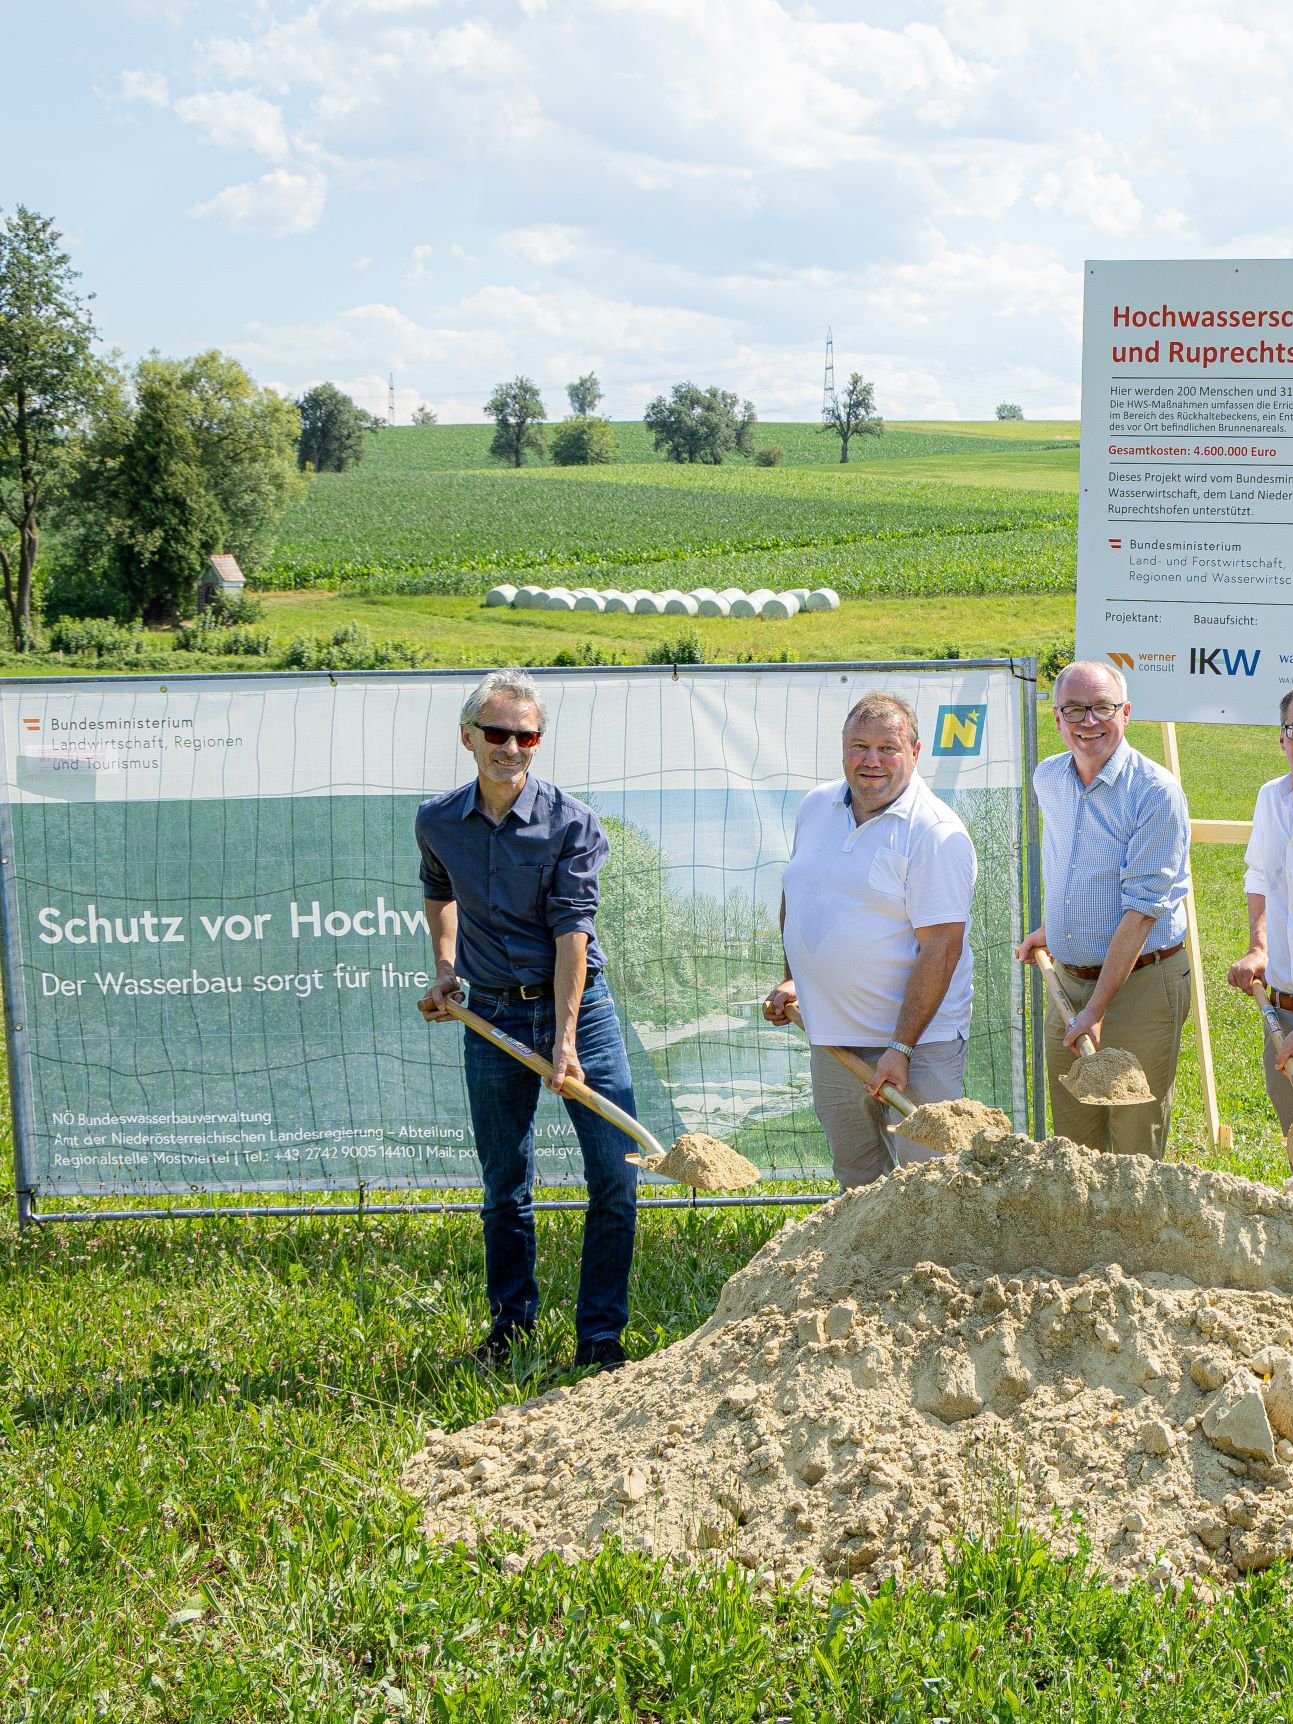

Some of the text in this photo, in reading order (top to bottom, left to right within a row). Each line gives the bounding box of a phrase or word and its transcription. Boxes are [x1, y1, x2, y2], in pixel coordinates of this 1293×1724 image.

[1112, 340, 1159, 363] und
[1110, 386, 1131, 396] Hier
[1135, 386, 1174, 397] werden
[1177, 387, 1196, 397] 200
[1200, 387, 1253, 397] Menschen
[1256, 387, 1276, 397] und
[1280, 388, 1292, 397] 31
[1110, 400, 1124, 409] Die
[1127, 400, 1209, 410] HWS-Maßnahmen
[1211, 401, 1254, 410] umfassen
[1256, 401, 1270, 410] die
[1110, 411, 1121, 420] im
[1123, 411, 1156, 420] Bereich
[1159, 411, 1174, 420] des
[1177, 411, 1260, 422] Rückhaltebeckens,
[1262, 412, 1276, 421] ein
[1109, 422, 1125, 431] des
[1144, 423, 1158, 431] Ort
[1161, 423, 1215, 432] befindlichen
[1219, 424, 1287, 433] Brunnenareals.
[1108, 445, 1276, 457] Gesamtkosten: 4.600.000 Euro
[1109, 472, 1141, 483] Dieses
[1145, 472, 1181, 485] Projekt
[1184, 473, 1207, 483] wird
[1210, 476, 1233, 484] vom
[1108, 488, 1200, 501] Wasserwirtschaft,
[1203, 489, 1226, 499] dem
[1230, 489, 1254, 500] Land
[1108, 504, 1254, 517] Ruprechtshofen unterstützt.
[1130, 540, 1242, 552] Bundesministerium
[1129, 555, 1286, 570] Land- und Forstwirtschaft,
[1129, 570, 1182, 584] Regionen
[1186, 572, 1207, 582] und
[1105, 612, 1162, 624] Projektant:
[1194, 614, 1258, 626] Bauaufsicht:
[1138, 652, 1176, 662] werner
[1190, 648, 1261, 676] IKW
[1138, 663, 1175, 673] consult
[51, 718, 193, 731] Bundesministerium
[52, 735, 243, 751] Landwirtschaft, Regionen
[53, 758, 159, 771] und Tourismus
[38, 904, 184, 945] Schutz
[200, 911, 272, 942] vor
[42, 972, 86, 996] Der
[94, 969, 242, 996] Wasserbau
[254, 969, 323, 998] sorgt
[333, 963, 370, 989] für
[382, 962, 429, 988] Ihre
[53, 1110, 272, 1126] NÖ Bundeswasserbauverwaltung
[54, 1133, 79, 1146] Amt
[84, 1133, 105, 1146] der
[112, 1131, 265, 1145] Niederösterreichischen
[271, 1125, 383, 1144] Landesregierung
[399, 1125, 464, 1142] Abteilung
[55, 1151, 149, 1169] Regionalstelle
[154, 1151, 230, 1164] Mostviertel
[274, 1148, 299, 1161] +43
[305, 1147, 338, 1160] 2742
[341, 1146, 376, 1159] 9005
[381, 1146, 415, 1159] 14410
[427, 1145, 455, 1158] Mail:
